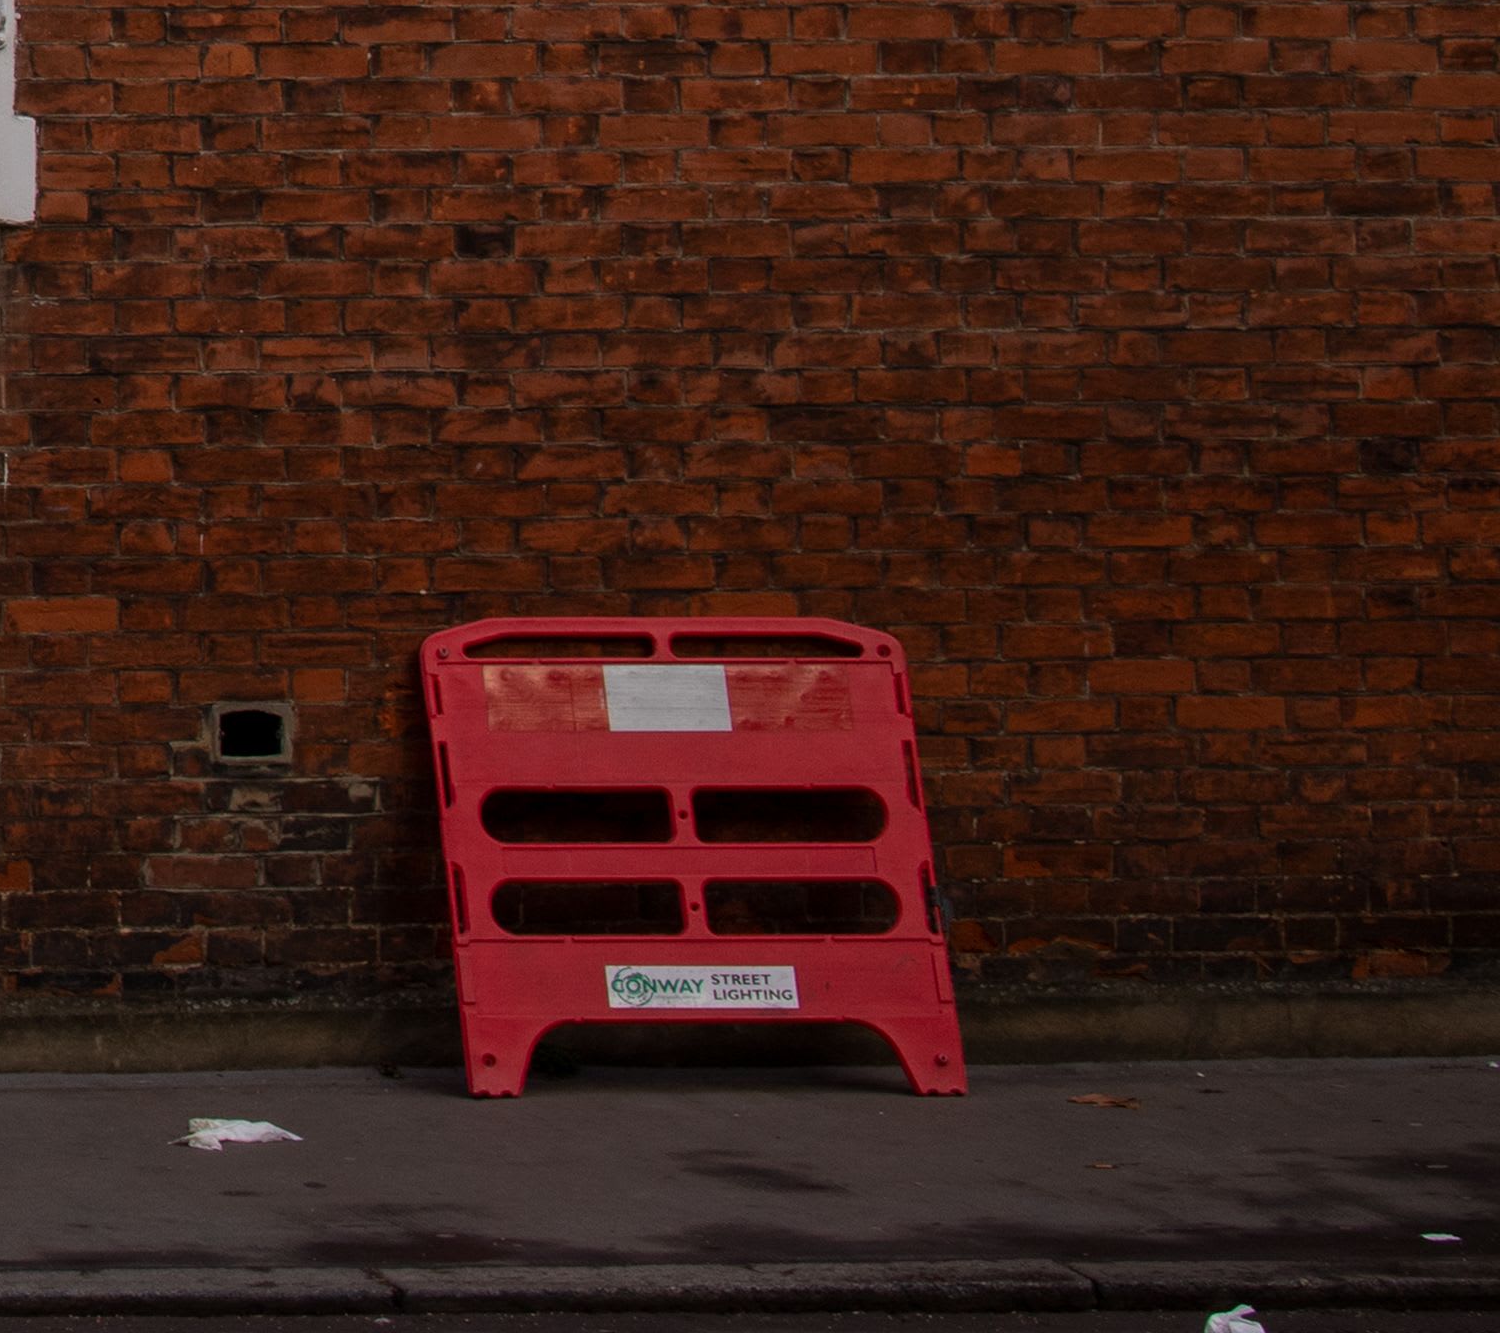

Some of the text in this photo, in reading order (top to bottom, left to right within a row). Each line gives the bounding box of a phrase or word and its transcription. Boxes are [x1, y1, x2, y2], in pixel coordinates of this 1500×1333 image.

[711, 974, 771, 985] STREET
[611, 978, 704, 994] CONWAY
[713, 989, 793, 1001] LIGHTING
